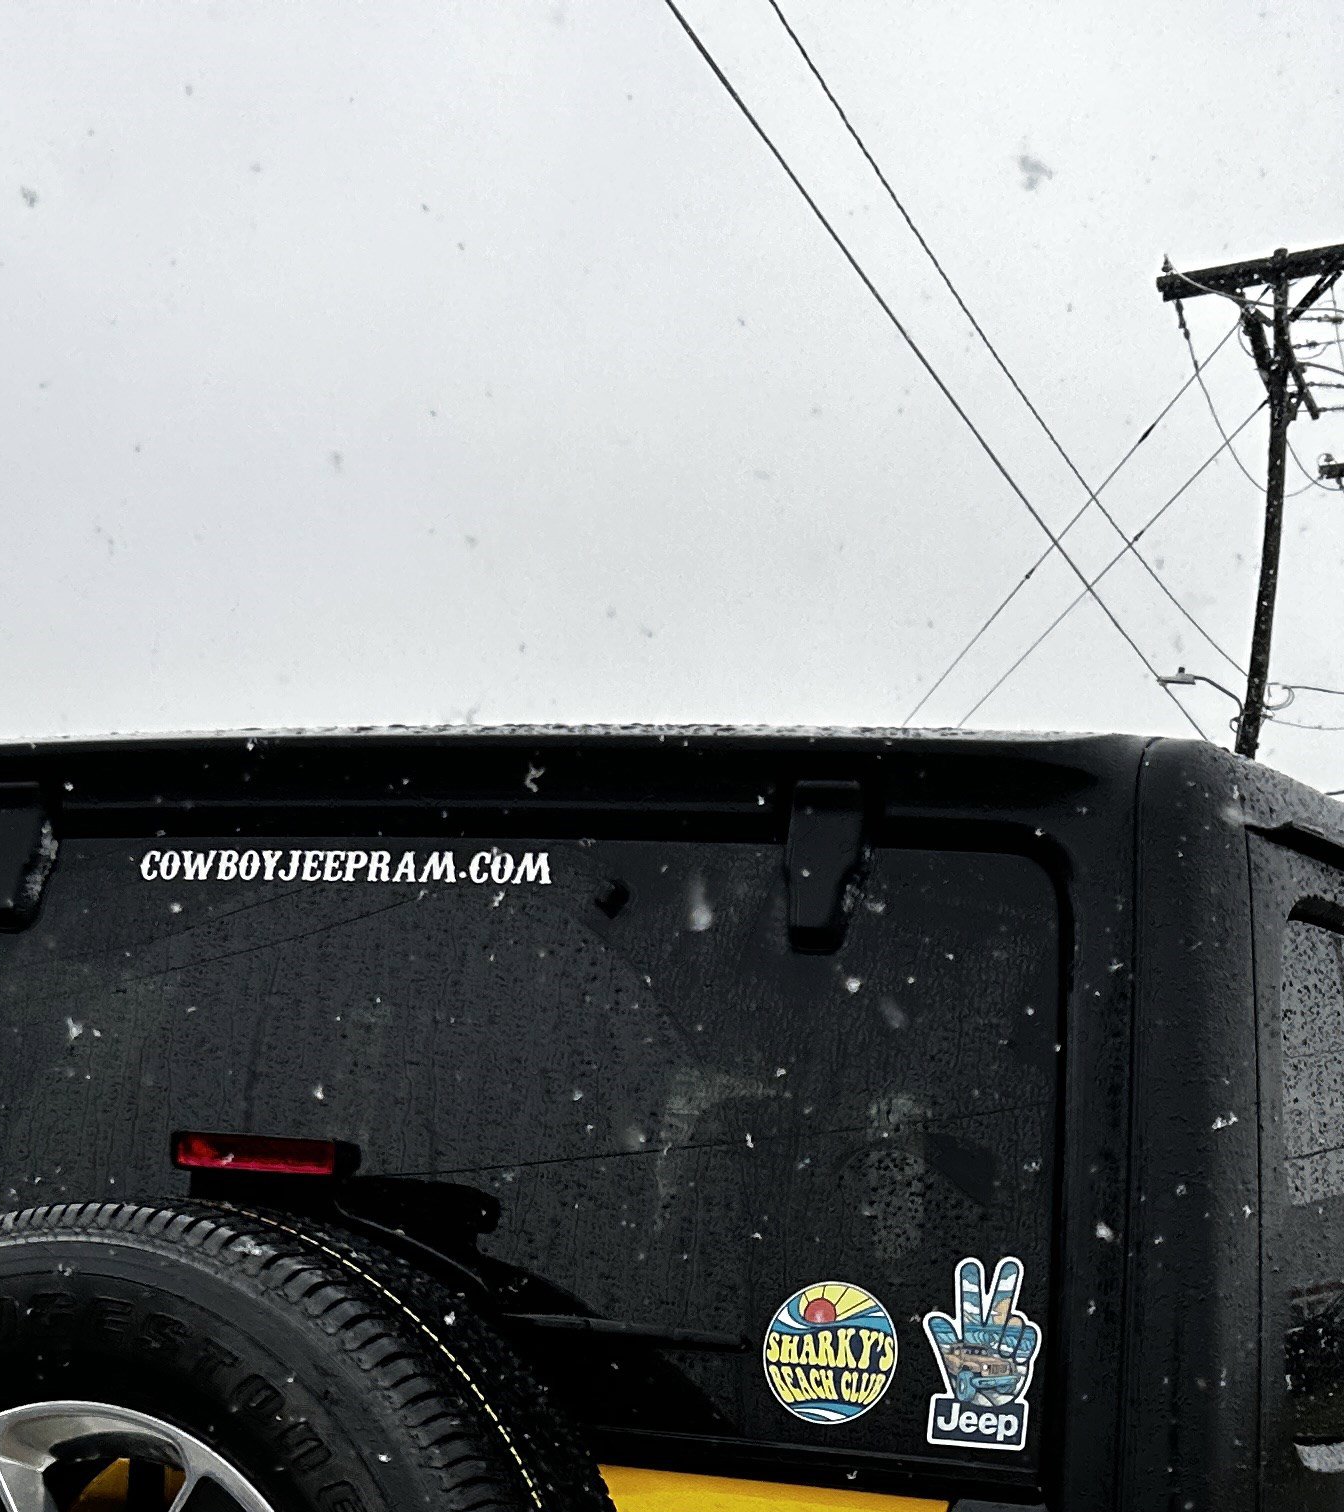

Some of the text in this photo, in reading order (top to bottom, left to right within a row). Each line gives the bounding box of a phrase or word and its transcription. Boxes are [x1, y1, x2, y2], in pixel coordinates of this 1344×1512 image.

[140, 849, 553, 885] COWBOYJEEPRAM.COM
[766, 1328, 894, 1371] SHARKY'S
[769, 1365, 887, 1405] BEACH CLUB
[936, 1403, 1019, 1441] Jeep
